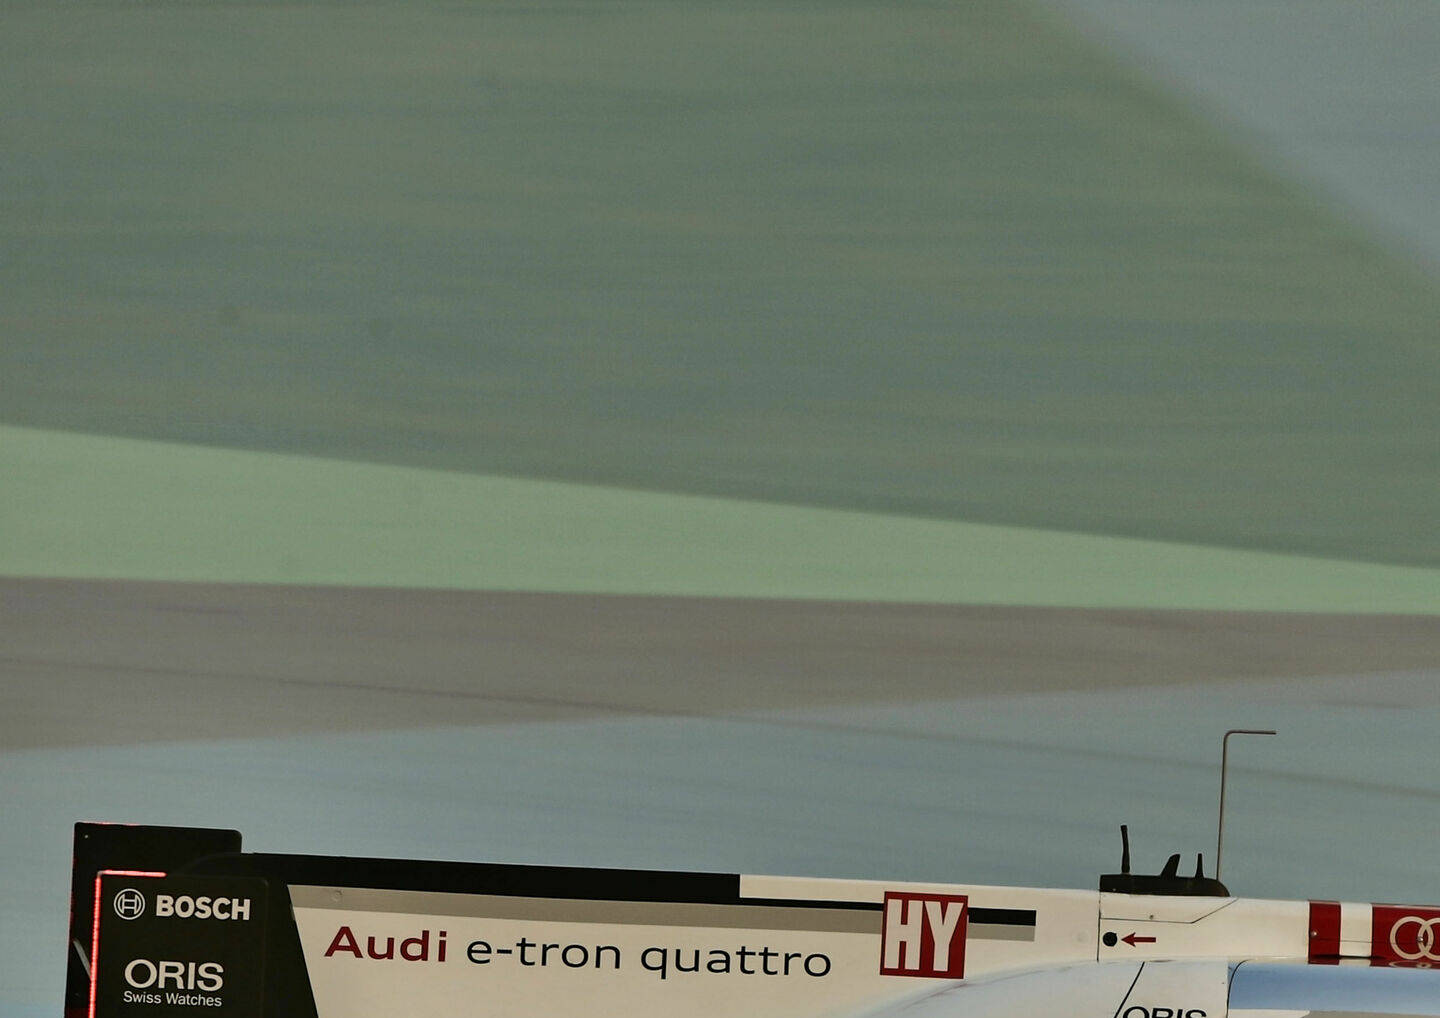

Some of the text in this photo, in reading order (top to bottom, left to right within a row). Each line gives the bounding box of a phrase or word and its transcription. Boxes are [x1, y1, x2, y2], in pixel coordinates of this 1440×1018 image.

[156, 894, 251, 920] BOSCH
[884, 899, 964, 972] HY
[324, 926, 832, 980] Audi e-tron quattro
[124, 958, 224, 992] ORIS
[123, 990, 222, 1007] Swiss Watches
